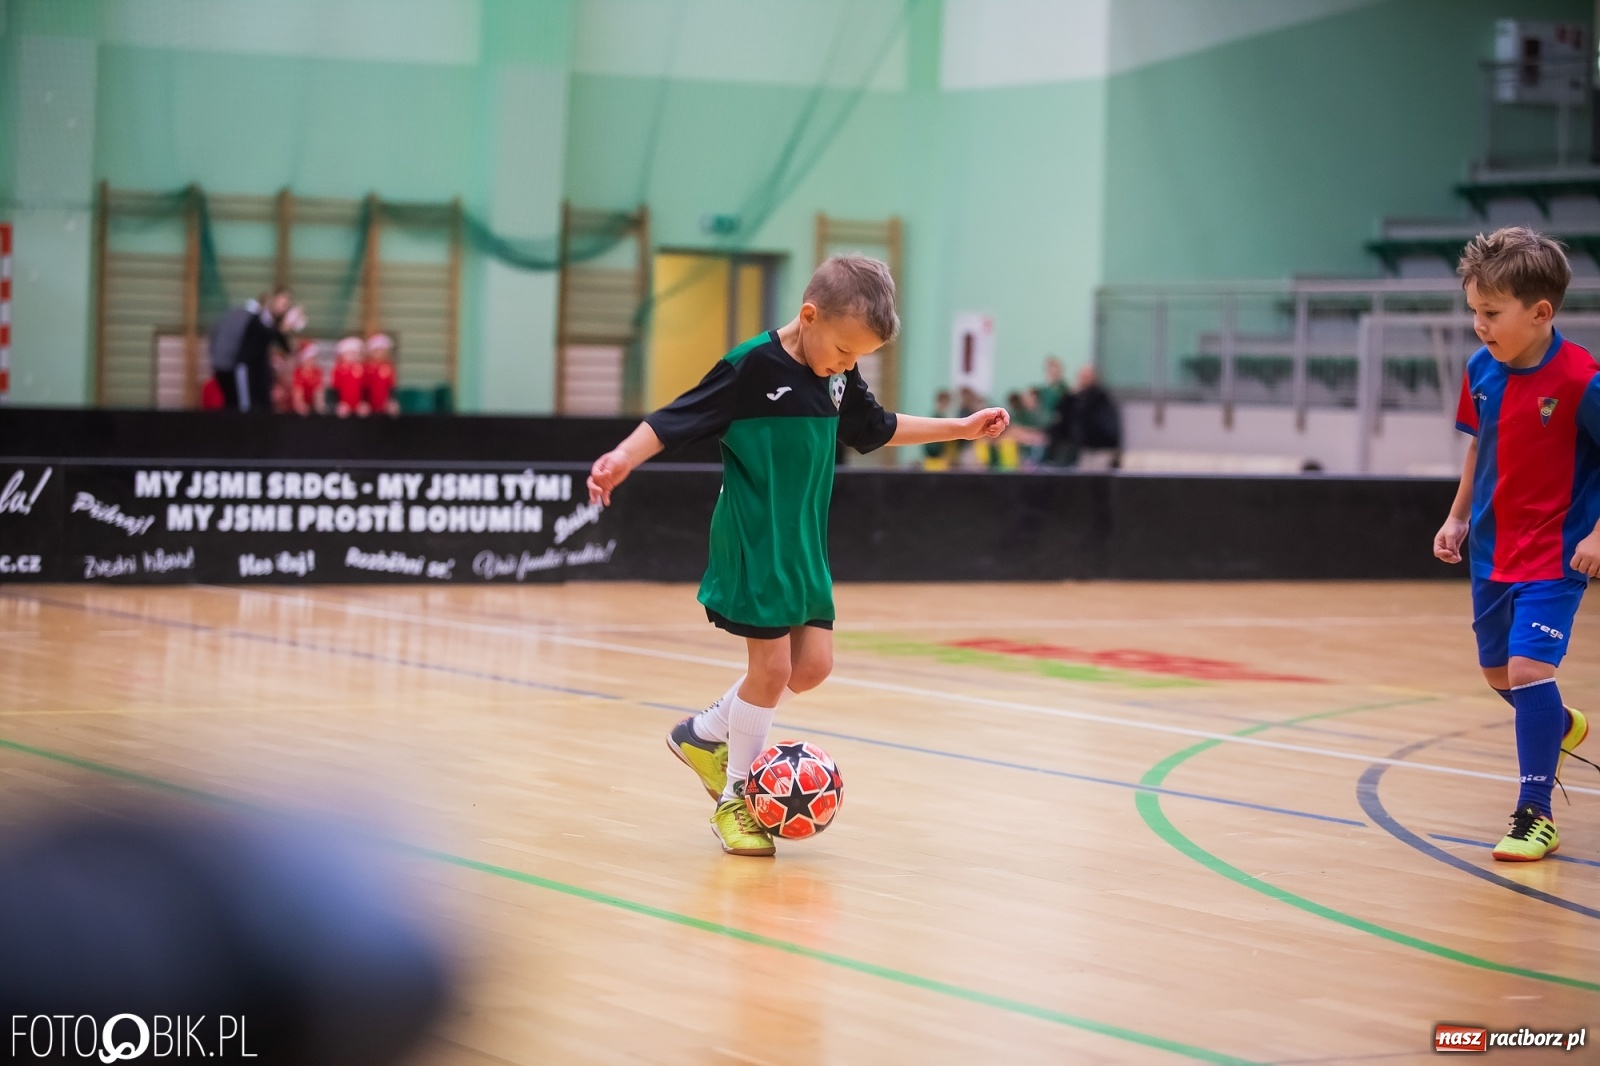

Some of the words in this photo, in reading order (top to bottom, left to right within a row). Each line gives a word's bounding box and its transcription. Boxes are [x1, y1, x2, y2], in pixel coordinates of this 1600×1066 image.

[135, 470, 184, 499] MY
[185, 471, 262, 500] JSME
[377, 472, 424, 500] MY
[425, 473, 499, 501] JSME
[500, 468, 572, 501] TÝM!
[166, 504, 215, 532] MY
[216, 504, 293, 532] JSME
[297, 500, 405, 533] PROSTĚ
[408, 500, 543, 533] BOHUMÍN
